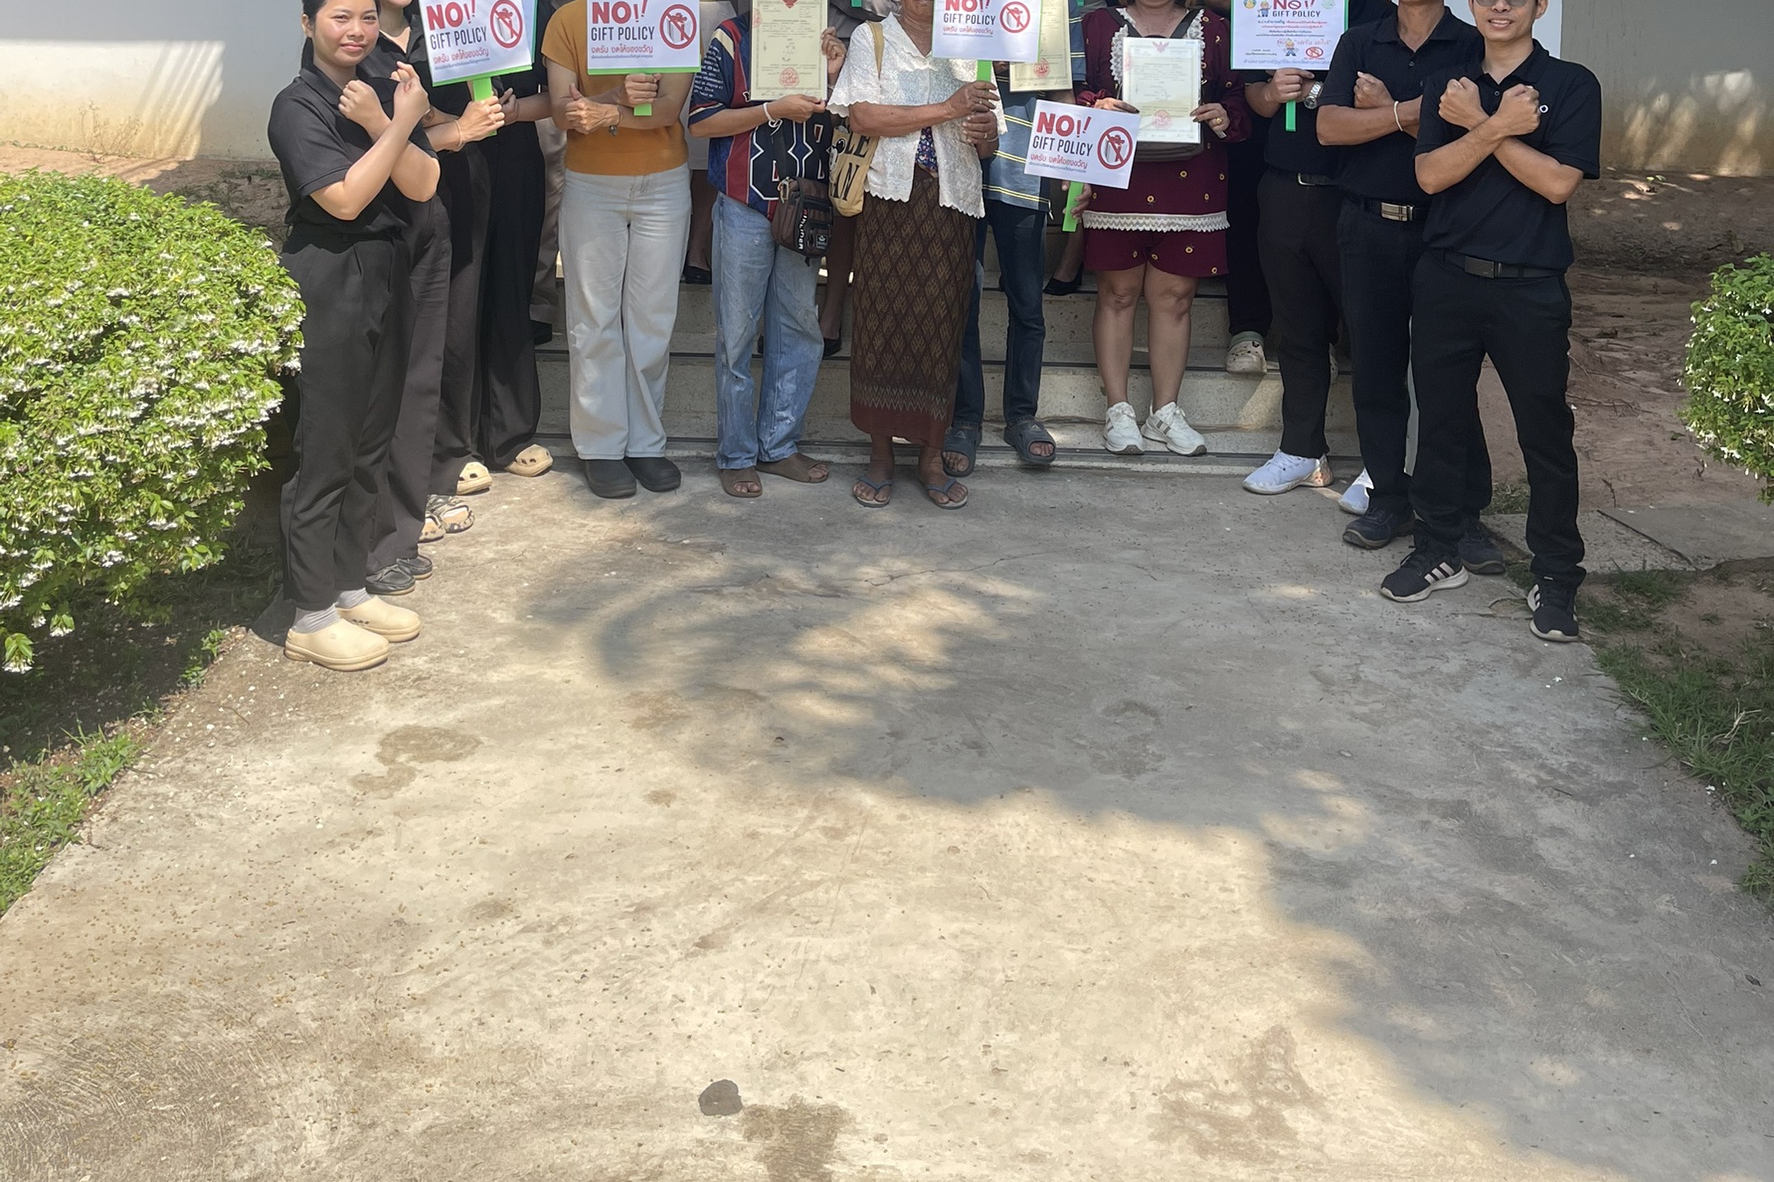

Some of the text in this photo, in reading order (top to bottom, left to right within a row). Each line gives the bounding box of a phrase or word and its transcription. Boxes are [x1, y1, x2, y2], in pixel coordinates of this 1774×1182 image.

[943, 13, 996, 25] GIFT POLICY
[430, 26, 487, 50] GIFT POLICY
[591, 26, 655, 41] GIFT POLICY
[1032, 135, 1093, 157] GIFT POLICY
